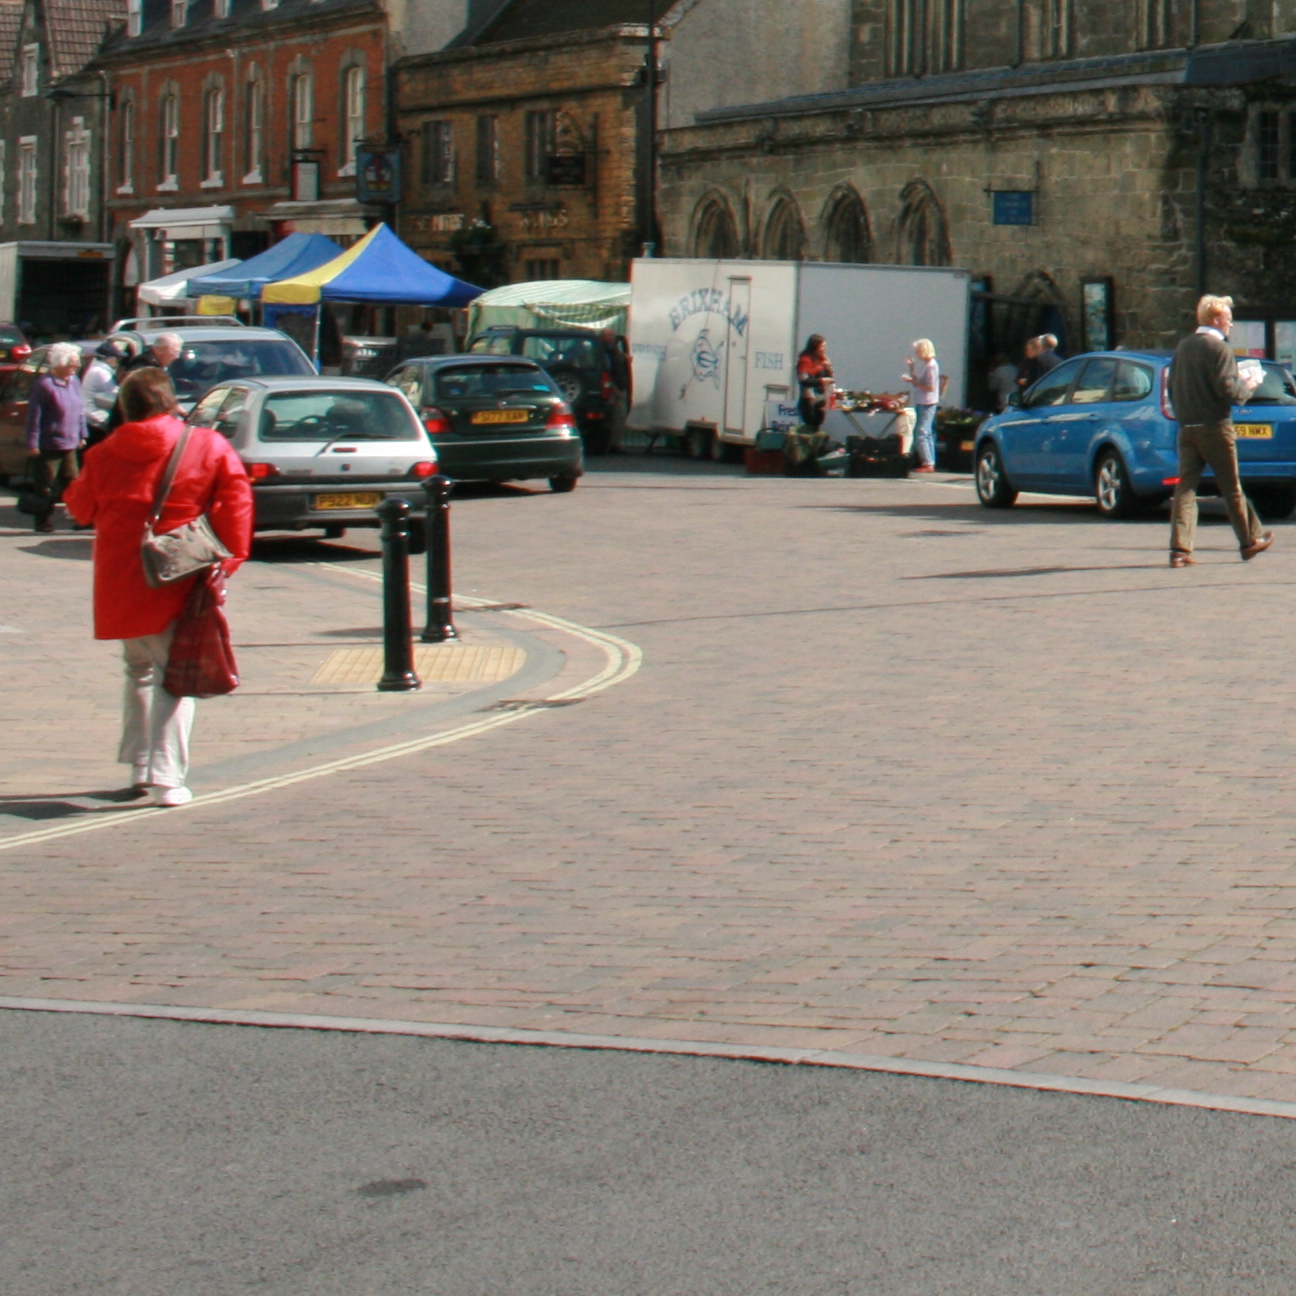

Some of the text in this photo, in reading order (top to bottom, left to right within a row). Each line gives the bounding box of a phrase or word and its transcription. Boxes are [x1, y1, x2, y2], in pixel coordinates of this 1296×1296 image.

[669, 287, 749, 337] BRIXHAM
[755, 351, 784, 371] FISH
[778, 404, 800, 417] Fres
[1235, 425, 1247, 436] 59
